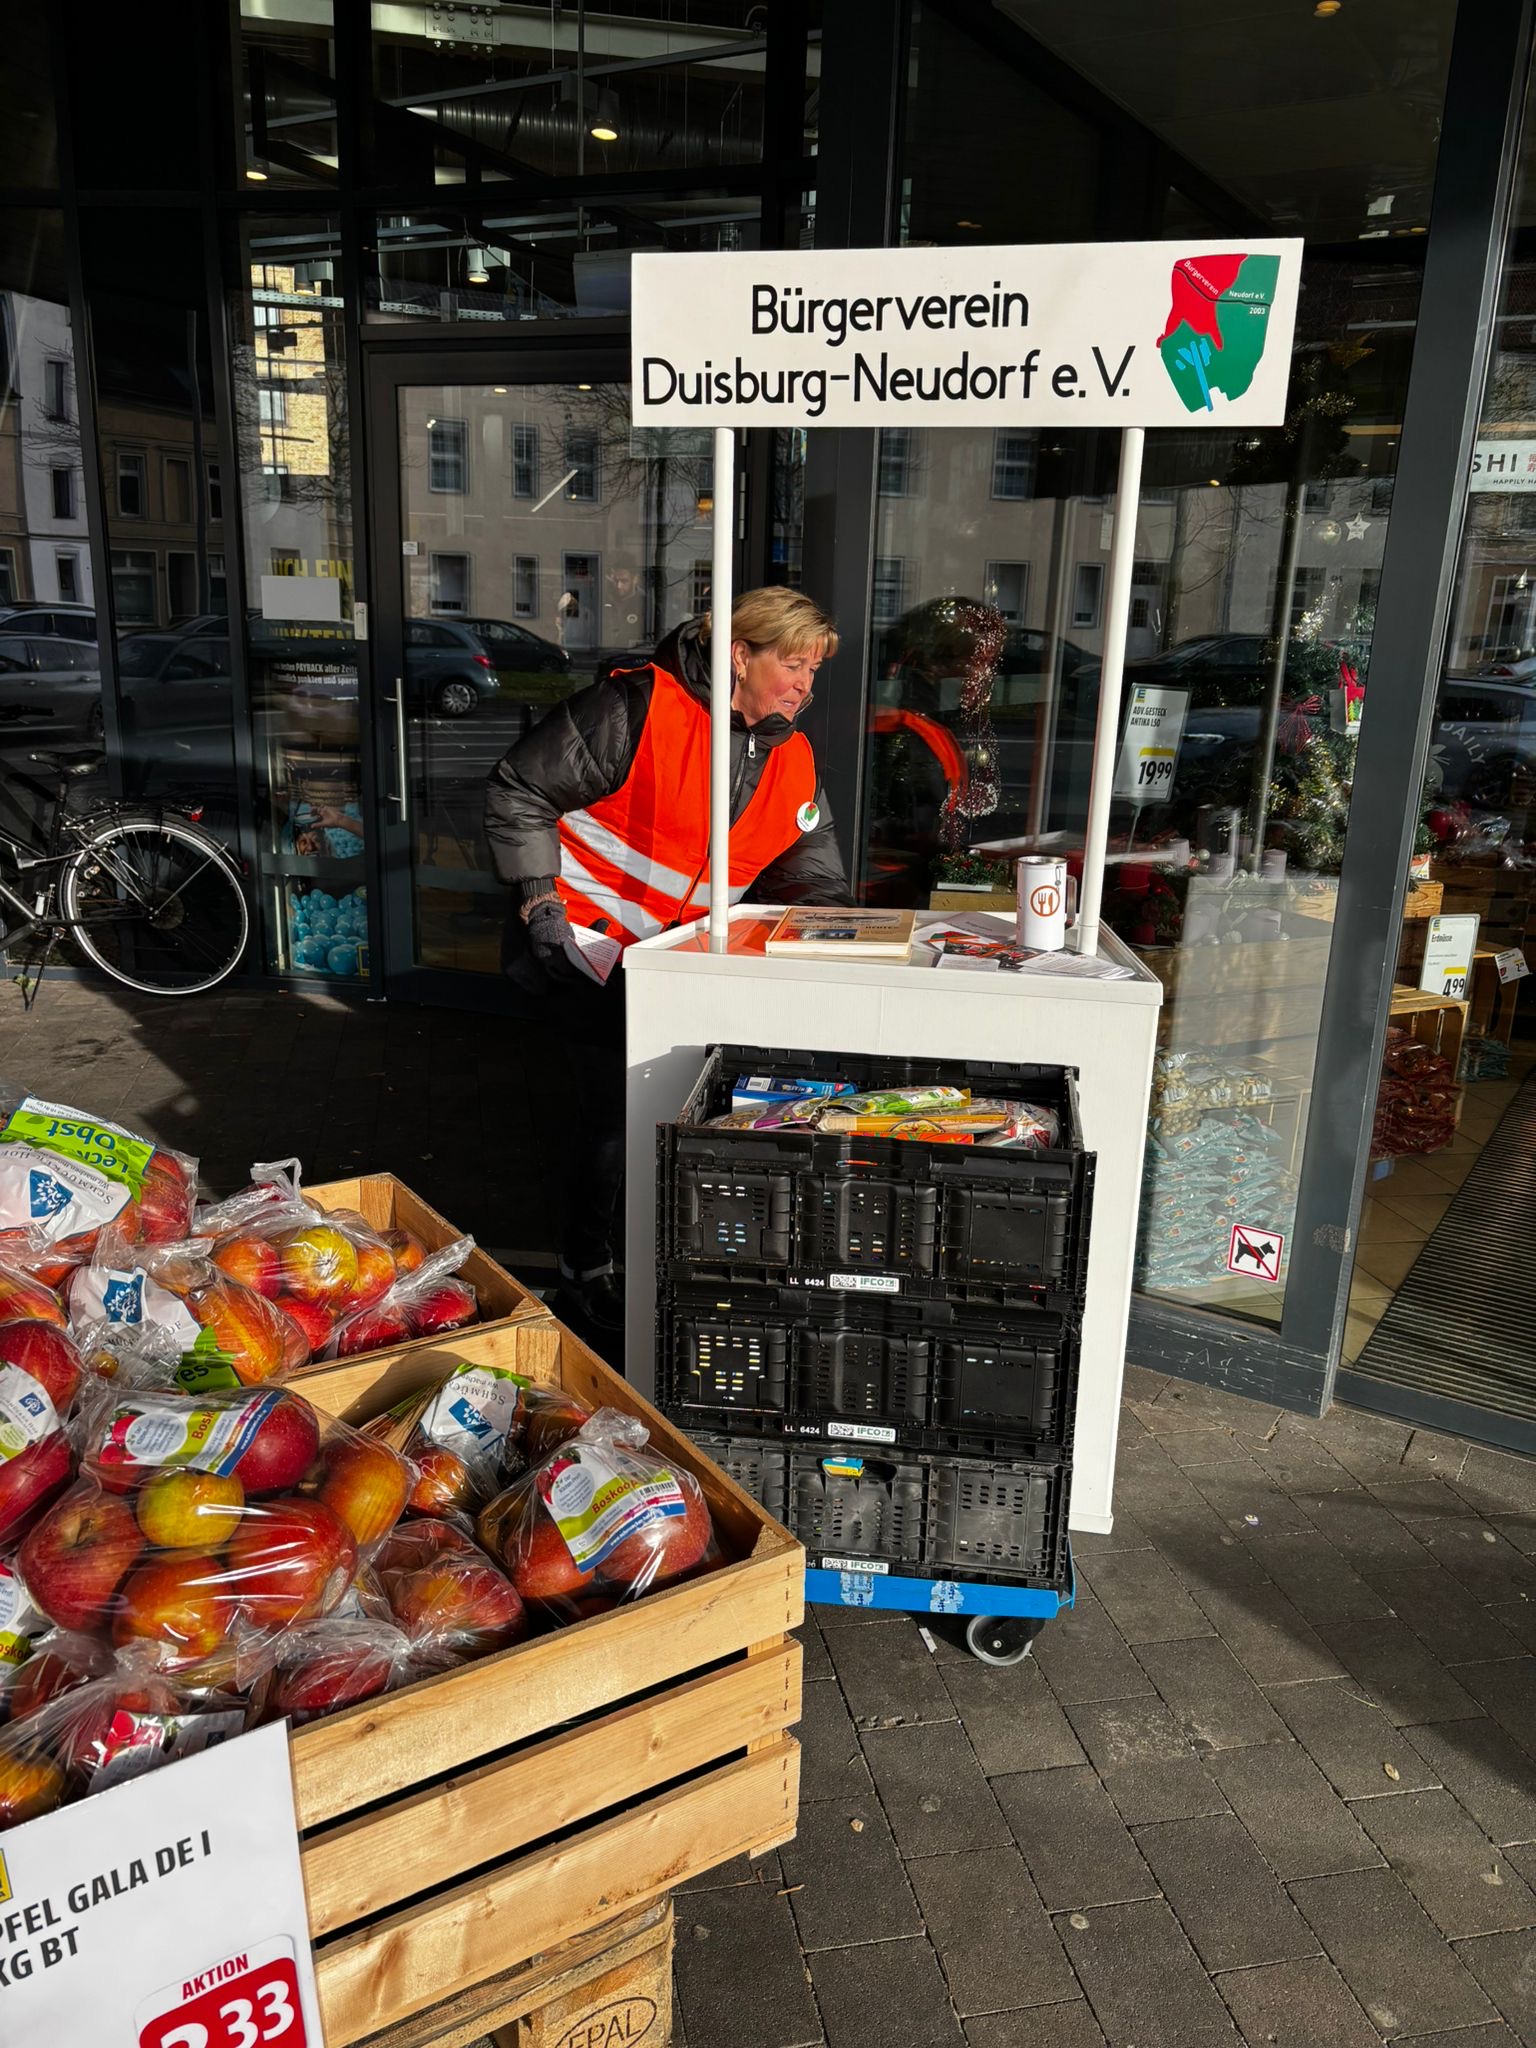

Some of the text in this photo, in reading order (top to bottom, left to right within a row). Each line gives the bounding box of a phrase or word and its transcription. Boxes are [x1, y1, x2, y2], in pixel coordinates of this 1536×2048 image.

[1229, 290, 1254, 299] Neudorf
[750, 281, 1030, 347] Bürgerverein
[1249, 306, 1266, 315] 2003
[642, 348, 1042, 417] Duisburg-Neudorf
[296, 662, 324, 673] PAYBACK
[1137, 761, 1173, 785] 19.99
[45, 1119, 117, 1151] Obst
[804, 1278, 825, 1287] 6424
[860, 1277, 885, 1288] IFCO
[799, 1426, 821, 1436] 6424
[857, 1426, 882, 1438] IFCO
[851, 1560, 875, 1571] IFCO
[67, 1858, 149, 1914] GALA
[155, 1837, 194, 1878] DE
[40, 1926, 80, 1969] BT
[182, 1953, 250, 2001] AKTION
